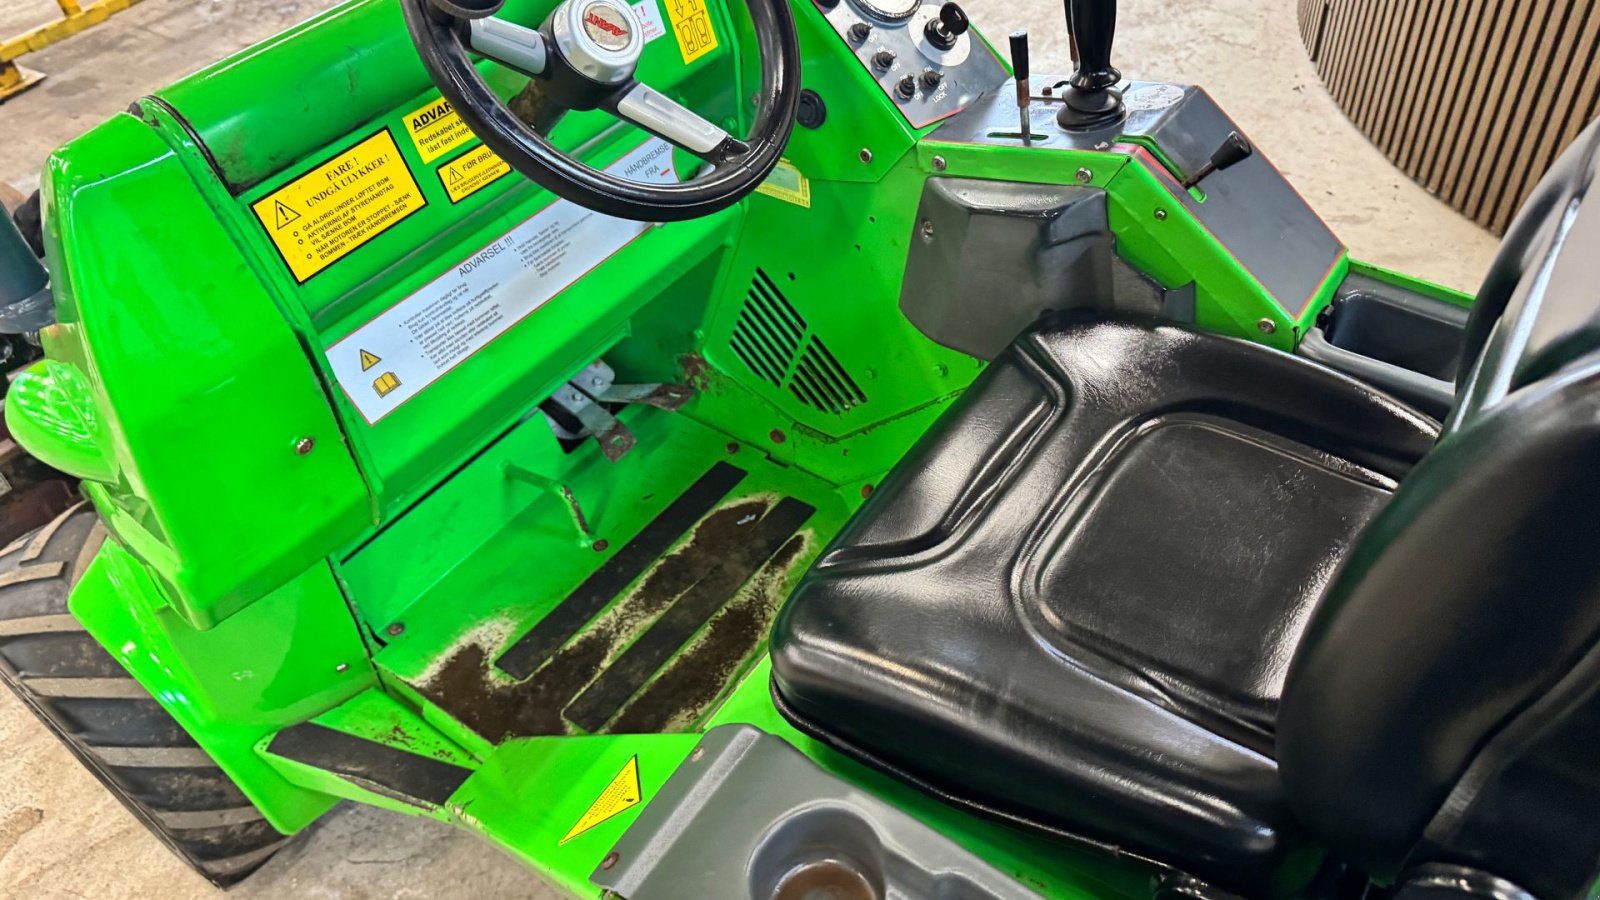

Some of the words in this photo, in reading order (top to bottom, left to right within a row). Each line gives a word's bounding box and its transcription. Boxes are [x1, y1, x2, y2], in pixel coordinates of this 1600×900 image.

[933, 92, 947, 103] LOCK
[418, 122, 455, 146] Redskabet
[427, 142, 440, 153] låst
[440, 134, 455, 146] fast
[325, 160, 354, 181] FARE
[353, 157, 359, 165] !
[462, 159, 477, 171] FØR
[477, 150, 494, 163] BRU
[624, 142, 670, 177] HÅNDBREMSE
[644, 164, 660, 178] FRA
[306, 182, 341, 207] UNDGÅ
[340, 157, 385, 187] ULYKKER
[302, 222, 312, 231] GÅ
[313, 210, 334, 226] ALDRIG
[334, 197, 355, 212] UNDER
[355, 184, 376, 200] LØFTET
[376, 176, 390, 187] BOM
[308, 215, 342, 239] AKTIVERING
[342, 210, 349, 218] AF
[350, 184, 394, 213] STYREHÅNDTAG
[316, 242, 329, 254] NÅR
[329, 225, 358, 245] MOTOREN
[357, 220, 366, 228] ER
[366, 204, 390, 222] STOPPET
[394, 192, 411, 205] SÆNK
[320, 241, 346, 260] BOMMEN
[349, 228, 366, 241] TRÆK
[366, 202, 407, 231] HÅNDBREMSEN
[321, 224, 343, 239] SÆNKE
[343, 215, 357, 226] BOM
[459, 242, 506, 277] ADVARSEL
[504, 235, 514, 247] !!!
